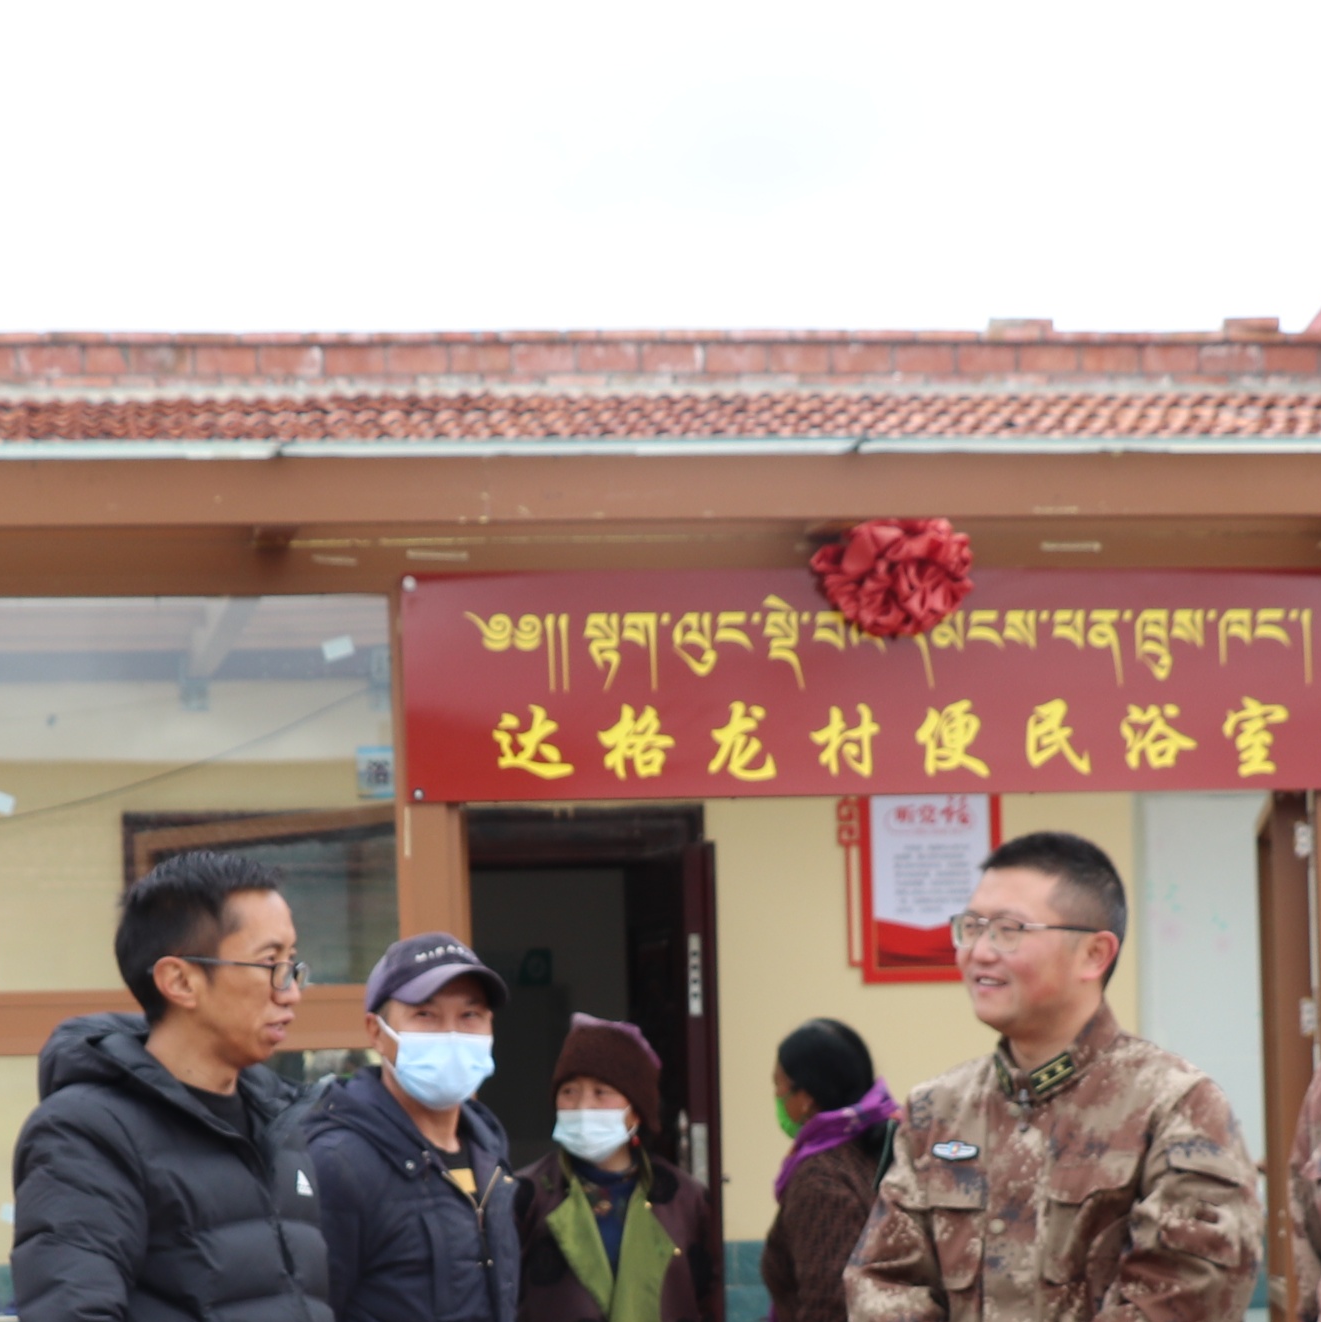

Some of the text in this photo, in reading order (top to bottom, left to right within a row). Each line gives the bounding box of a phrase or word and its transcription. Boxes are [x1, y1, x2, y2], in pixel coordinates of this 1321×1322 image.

[492, 697, 1289, 780] 达格龙村便民浴室
